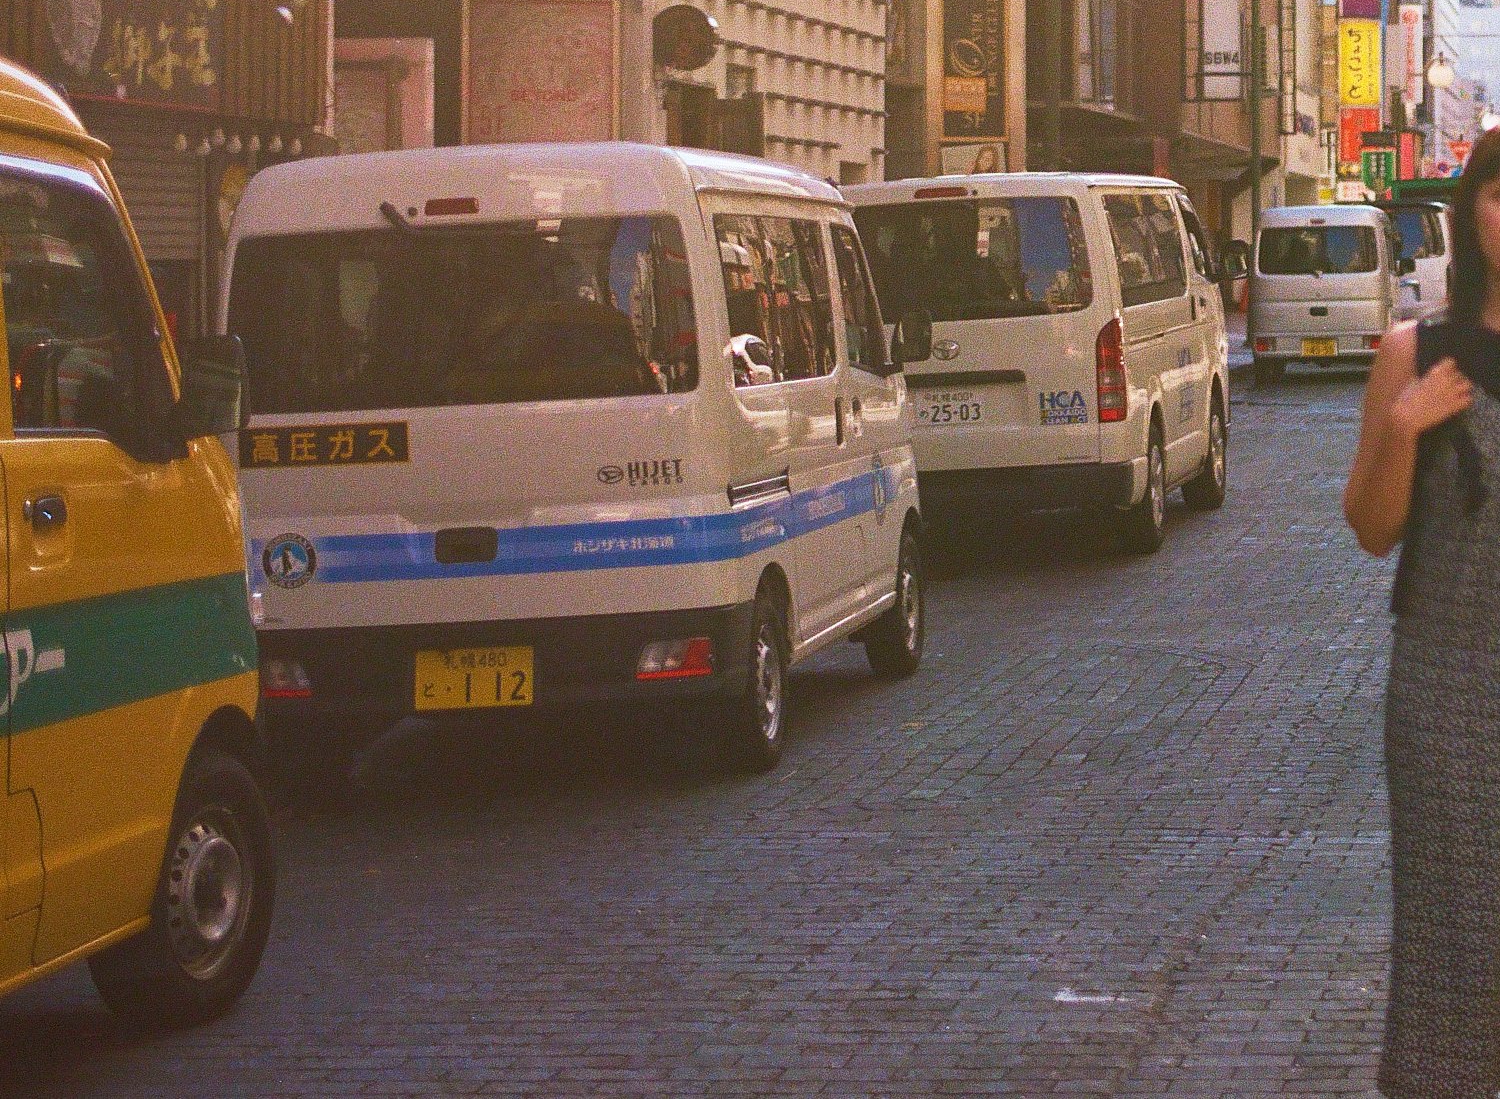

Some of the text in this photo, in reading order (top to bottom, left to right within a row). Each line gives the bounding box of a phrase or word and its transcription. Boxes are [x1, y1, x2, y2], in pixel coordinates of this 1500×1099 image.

[1039, 390, 1086, 408] HCA
[931, 403, 981, 423] 25-03
[253, 428, 395, 463] 高圧ガス
[627, 458, 682, 479] HIJET
